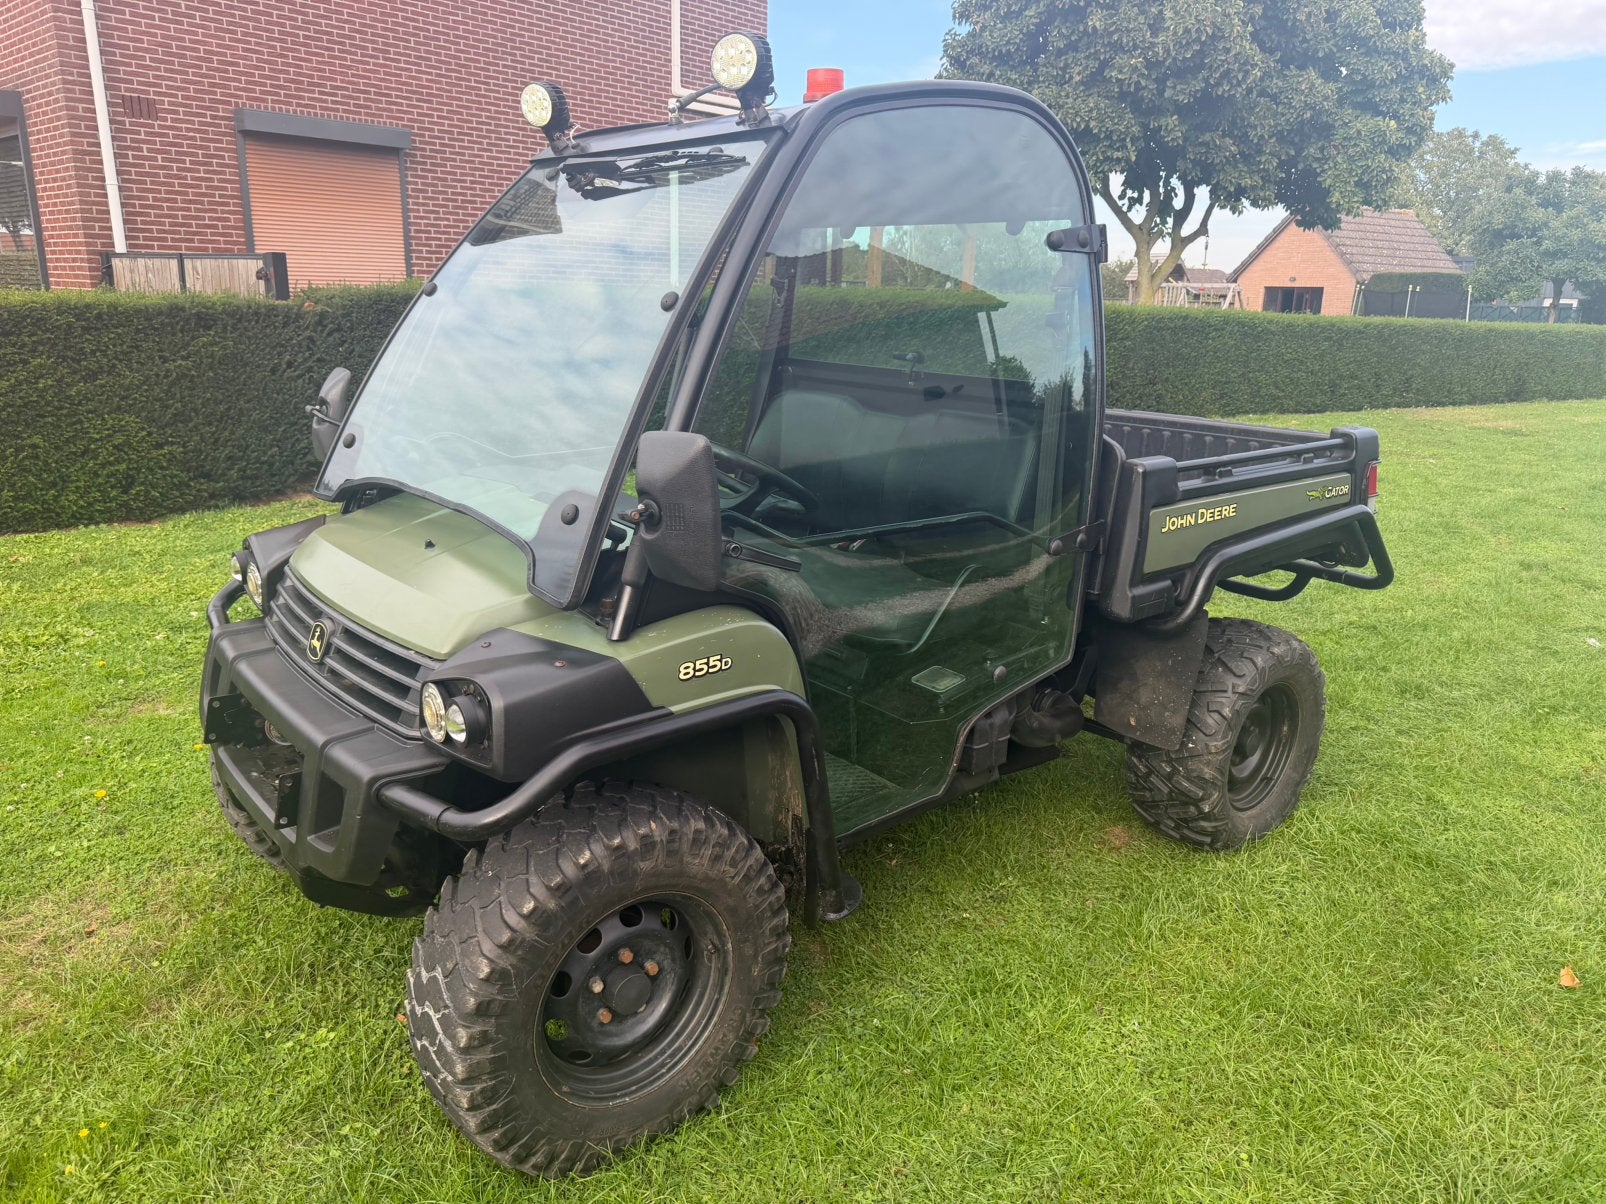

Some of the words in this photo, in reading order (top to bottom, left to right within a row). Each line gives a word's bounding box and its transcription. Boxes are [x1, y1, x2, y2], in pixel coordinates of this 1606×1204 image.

[1325, 485, 1349, 498] GATOR
[1161, 513, 1195, 533] JOHN
[1197, 503, 1237, 524] DEERE
[678, 654, 732, 680] 855D
